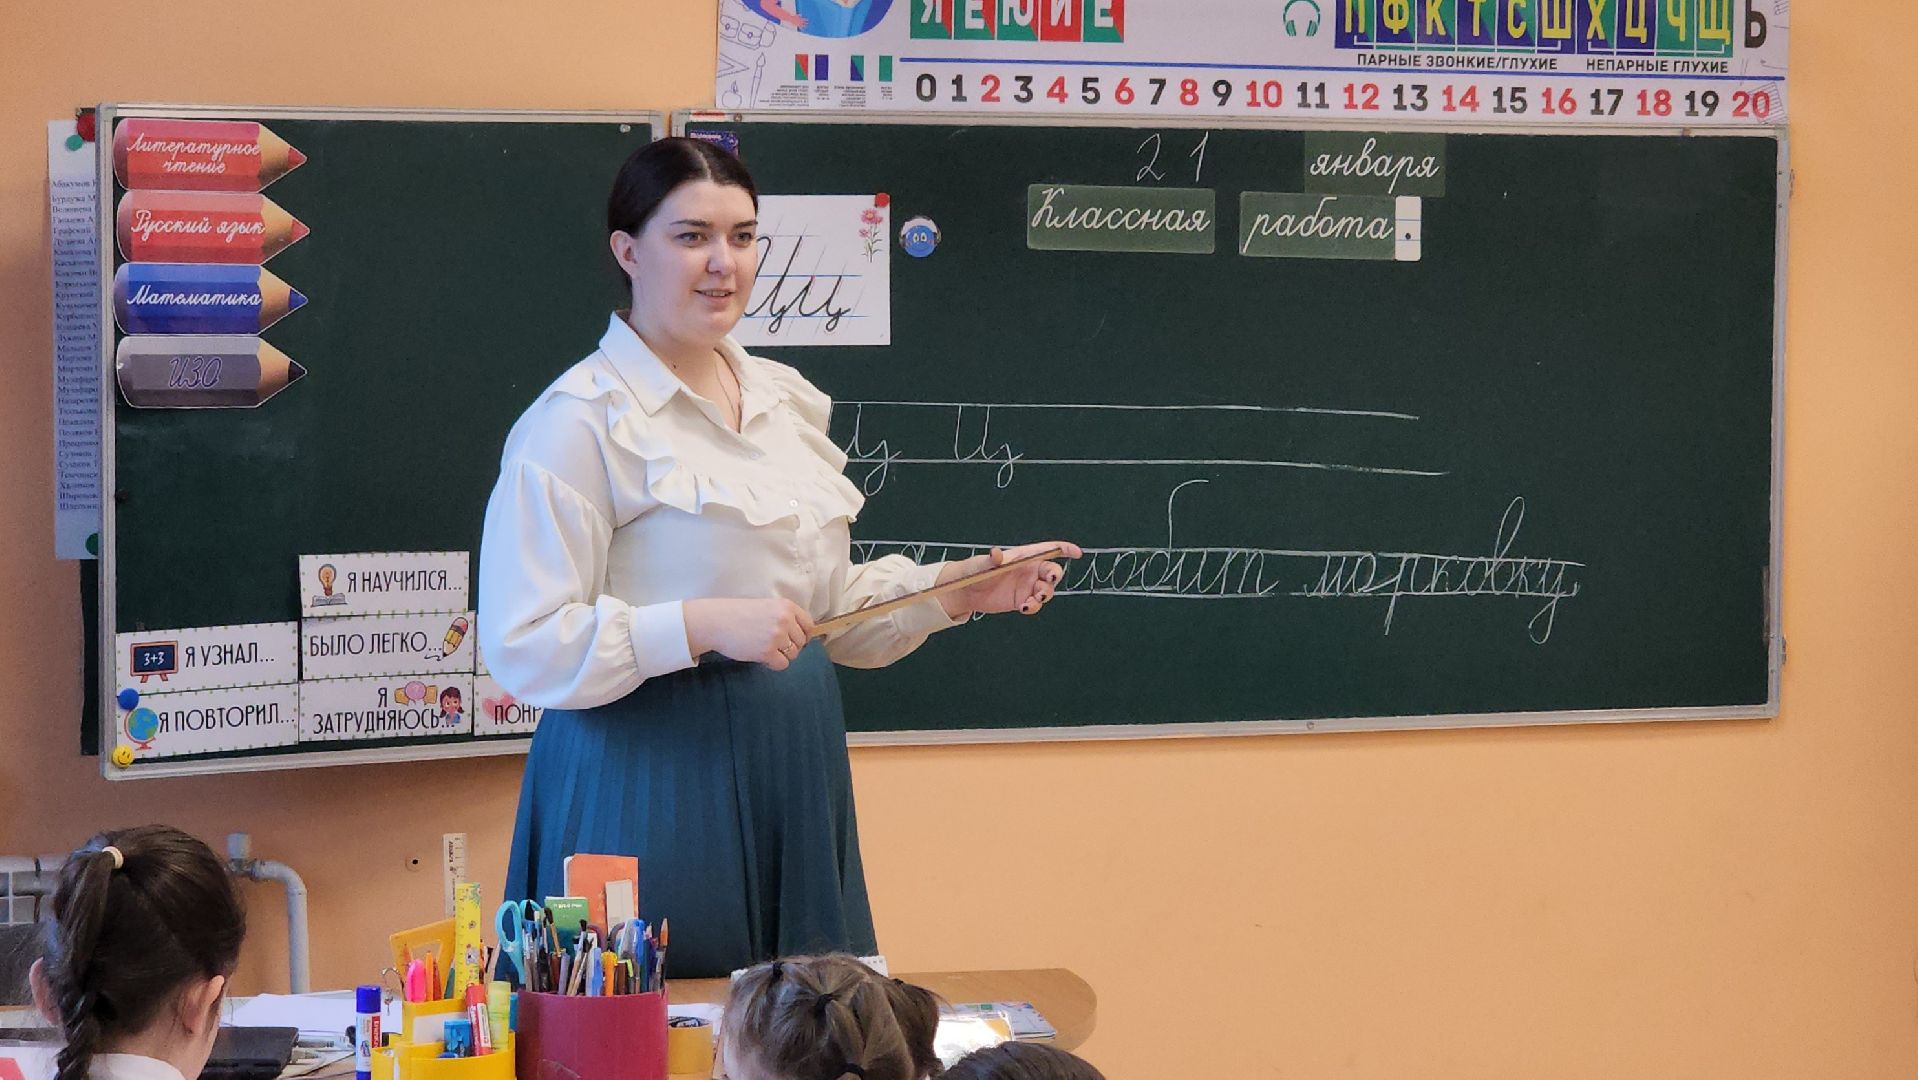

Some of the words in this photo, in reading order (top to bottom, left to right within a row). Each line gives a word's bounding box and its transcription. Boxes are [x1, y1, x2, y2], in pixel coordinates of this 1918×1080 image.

[1382, 0, 1410, 34] Ф
[1425, 0, 1447, 36] К
[1467, 0, 1487, 37] Т
[1506, 0, 1528, 39] С
[1541, 0, 1571, 39] Ш
[1586, 0, 1606, 40] Х
[1625, 0, 1648, 43] Ц
[1666, 0, 1686, 42] Ч
[1700, 0, 1731, 45] Щ
[1357, 53, 1422, 67] ПАРНЫЕ
[1426, 55, 1558, 70] ЗВОНКИЕ/ГЛУХИЕ
[1586, 59, 1669, 73] НЕПАРНЫЕ
[1673, 60, 1729, 74] ГЛУХИЕ
[916, 73, 937, 103] 0
[951, 74, 967, 103] 1
[980, 74, 1001, 103] 2
[1013, 75, 1034, 104] 3
[1046, 76, 1068, 104] 4
[1081, 77, 1101, 105] 5
[1114, 78, 1135, 105] 6
[1149, 78, 1167, 105] 7
[1179, 78, 1199, 106] 8
[1212, 79, 1233, 107] 9
[1246, 80, 1283, 108] 10
[1297, 81, 1330, 109] 11
[1343, 83, 1380, 110] 12
[1393, 84, 1429, 112] 13
[1442, 85, 1480, 112] 14
[1492, 86, 1528, 114] 15
[1541, 87, 1578, 115] 16
[1590, 88, 1624, 116] 17
[1636, 89, 1673, 117] 18
[1685, 90, 1720, 117] 19
[1732, 90, 1771, 118] 20
[127, 132, 261, 162] Литературное
[162, 160, 226, 174] чтение
[1309, 137, 1440, 194] января
[1031, 187, 1211, 232] Классная
[131, 209, 213, 242] Русский
[216, 219, 266, 243] язык
[126, 284, 263, 306] Математика
[167, 355, 224, 389] ИЗО
[347, 571, 357, 593] Я
[361, 570, 463, 593] НАУЧИЛСЯ...
[185, 646, 196, 668] Я
[201, 642, 276, 667] УЗНАЛ...
[309, 633, 365, 657] БЫЛО
[368, 630, 443, 655] ЛЕГКО...
[143, 651, 165, 667] 3+3
[377, 686, 388, 708] Я
[158, 711, 169, 733] Я
[174, 702, 296, 732] ПОВТОРИЛ...
[312, 708, 456, 735] ЗАТРУДНЯЮСЬ...
